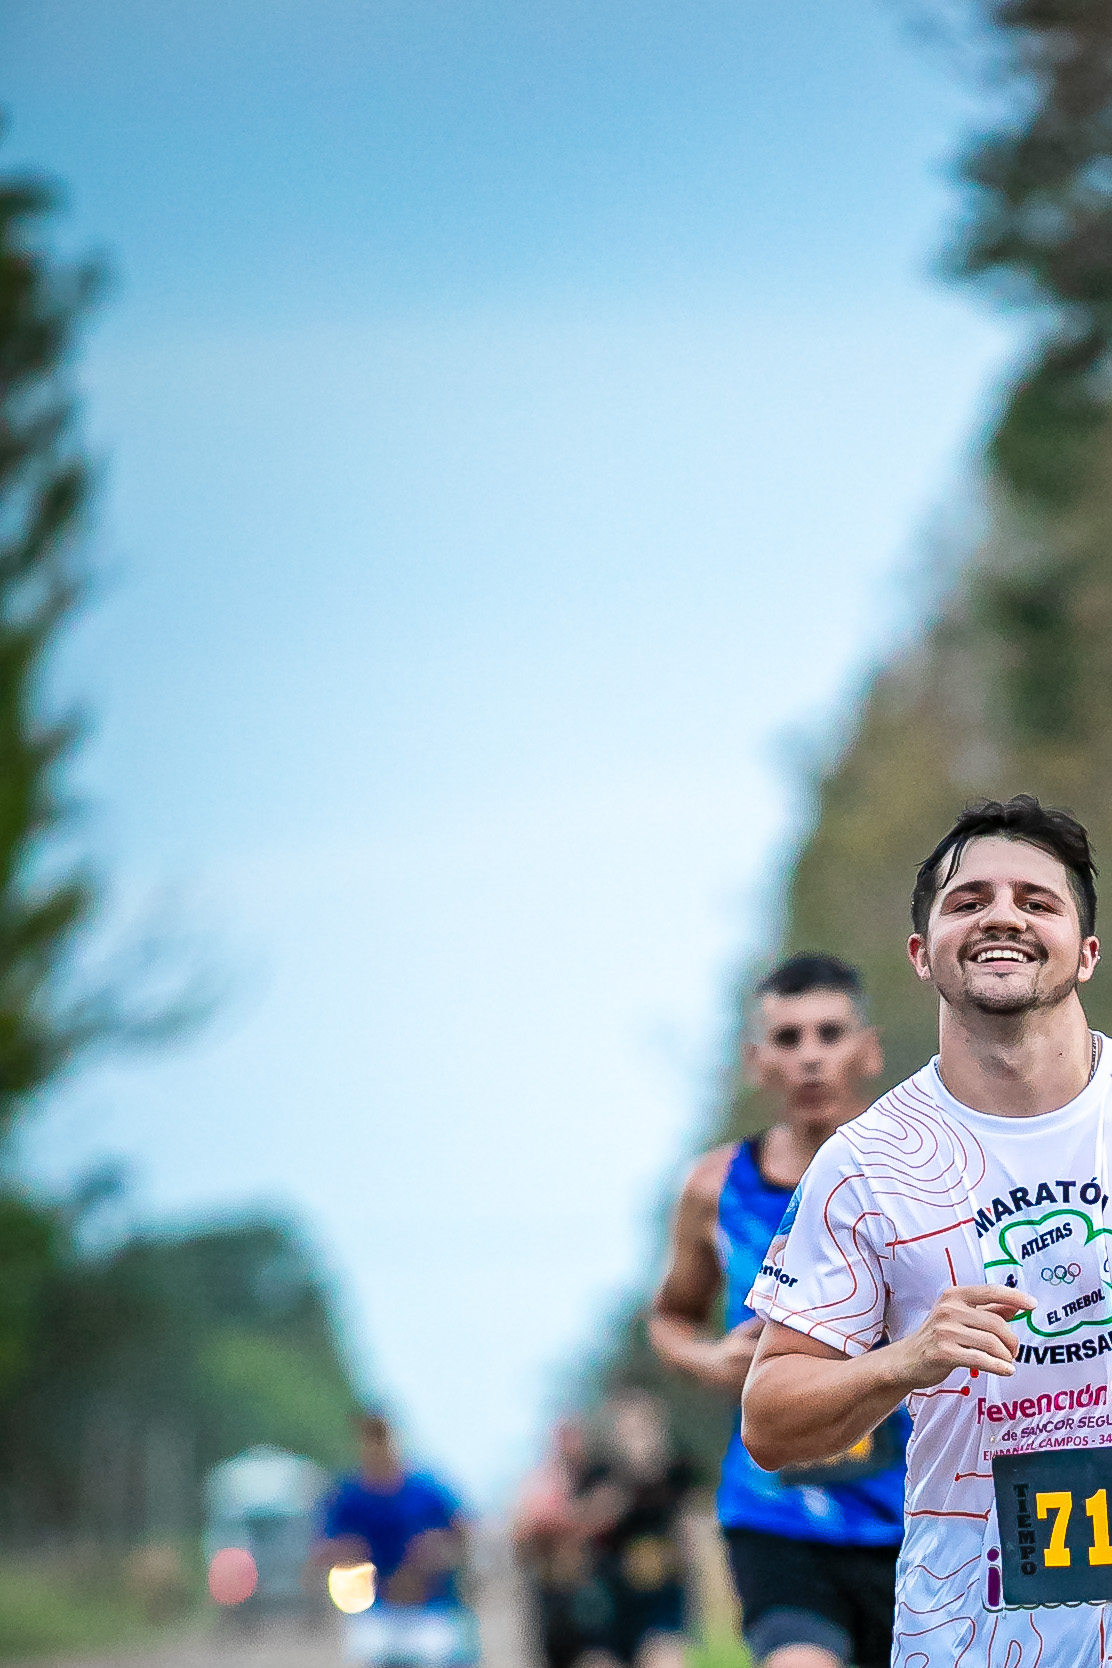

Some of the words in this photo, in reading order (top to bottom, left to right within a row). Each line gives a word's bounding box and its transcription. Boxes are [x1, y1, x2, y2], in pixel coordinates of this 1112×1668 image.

[974, 1177, 1110, 1239] MARATÓ
[1021, 1222, 1073, 1260] ATLETAS
[1046, 1309, 1062, 1326] EL
[1062, 1288, 1106, 1318] TREBOL
[1001, 1429, 1018, 1442] de
[1038, 1433, 1089, 1450] CAMPOS
[1012, 1483, 1038, 1576] TIEMPO
